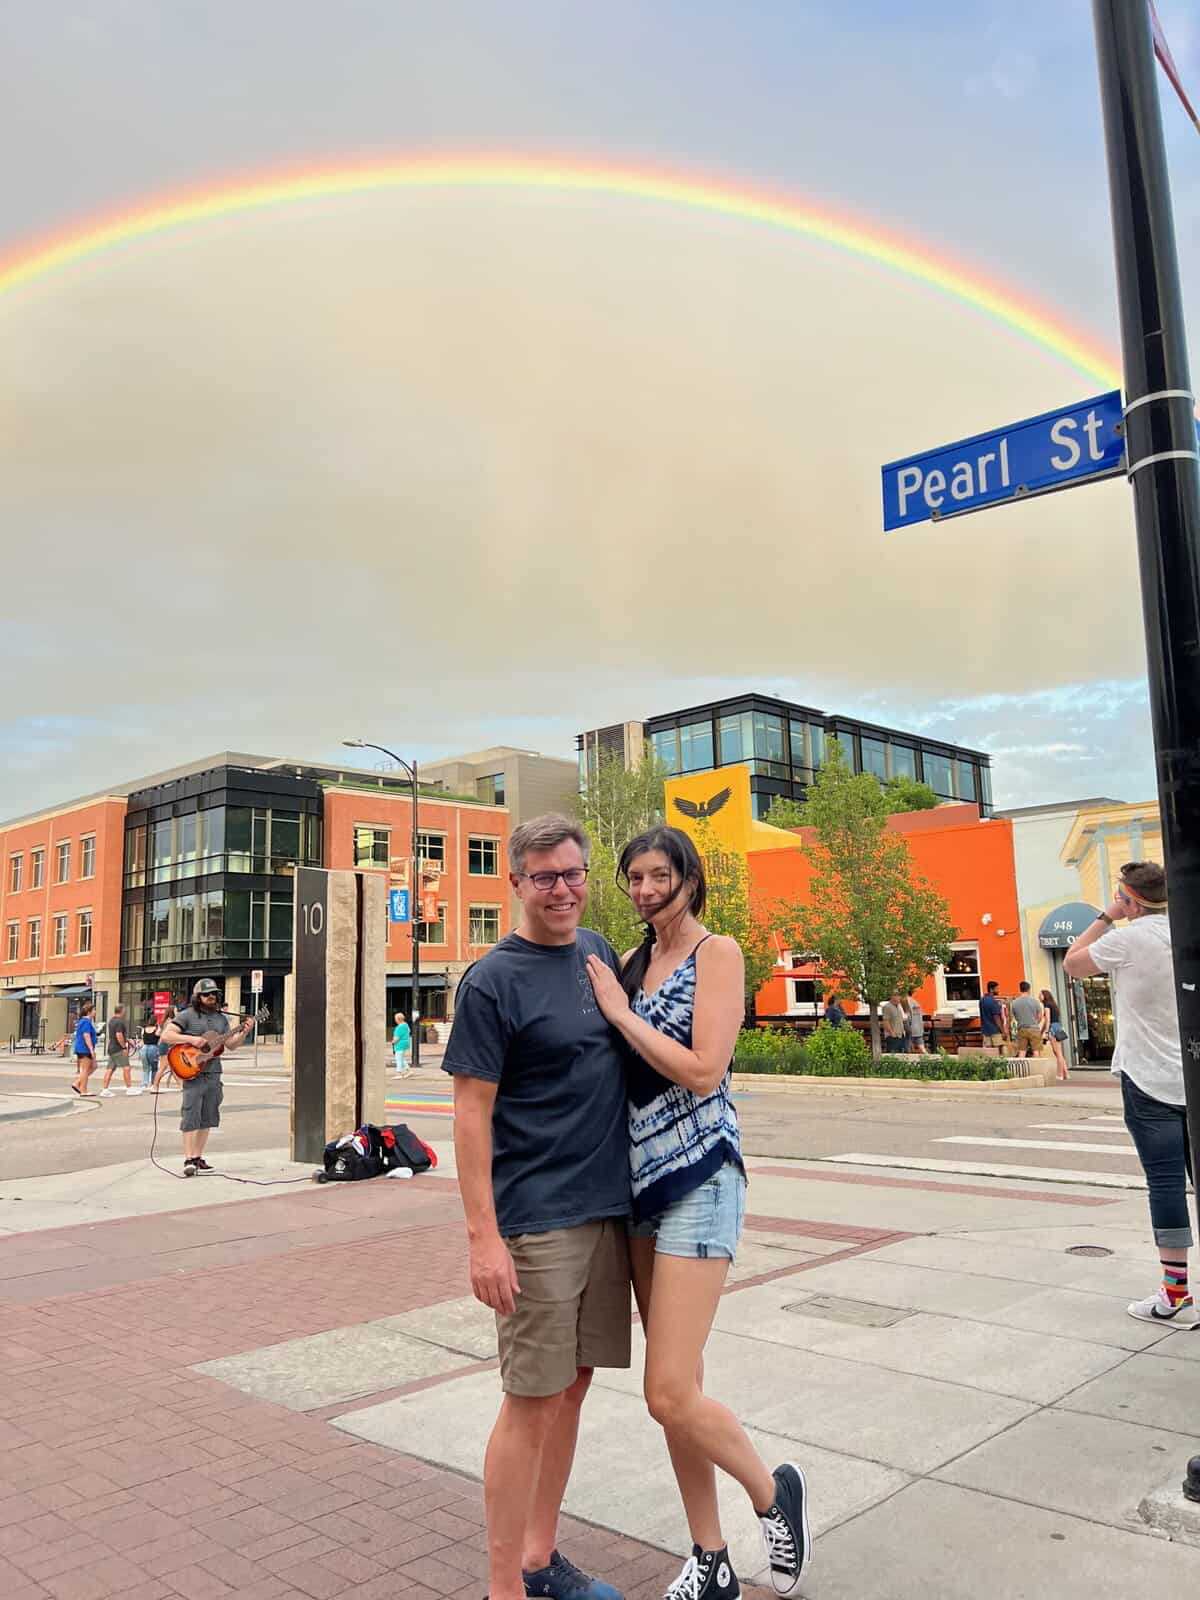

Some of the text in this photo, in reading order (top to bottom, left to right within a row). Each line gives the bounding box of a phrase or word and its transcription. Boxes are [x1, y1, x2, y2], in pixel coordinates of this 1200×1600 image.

[897, 409, 1105, 517] Pearl St
[303, 902, 323, 935] 10
[1053, 920, 1073, 930] 948
